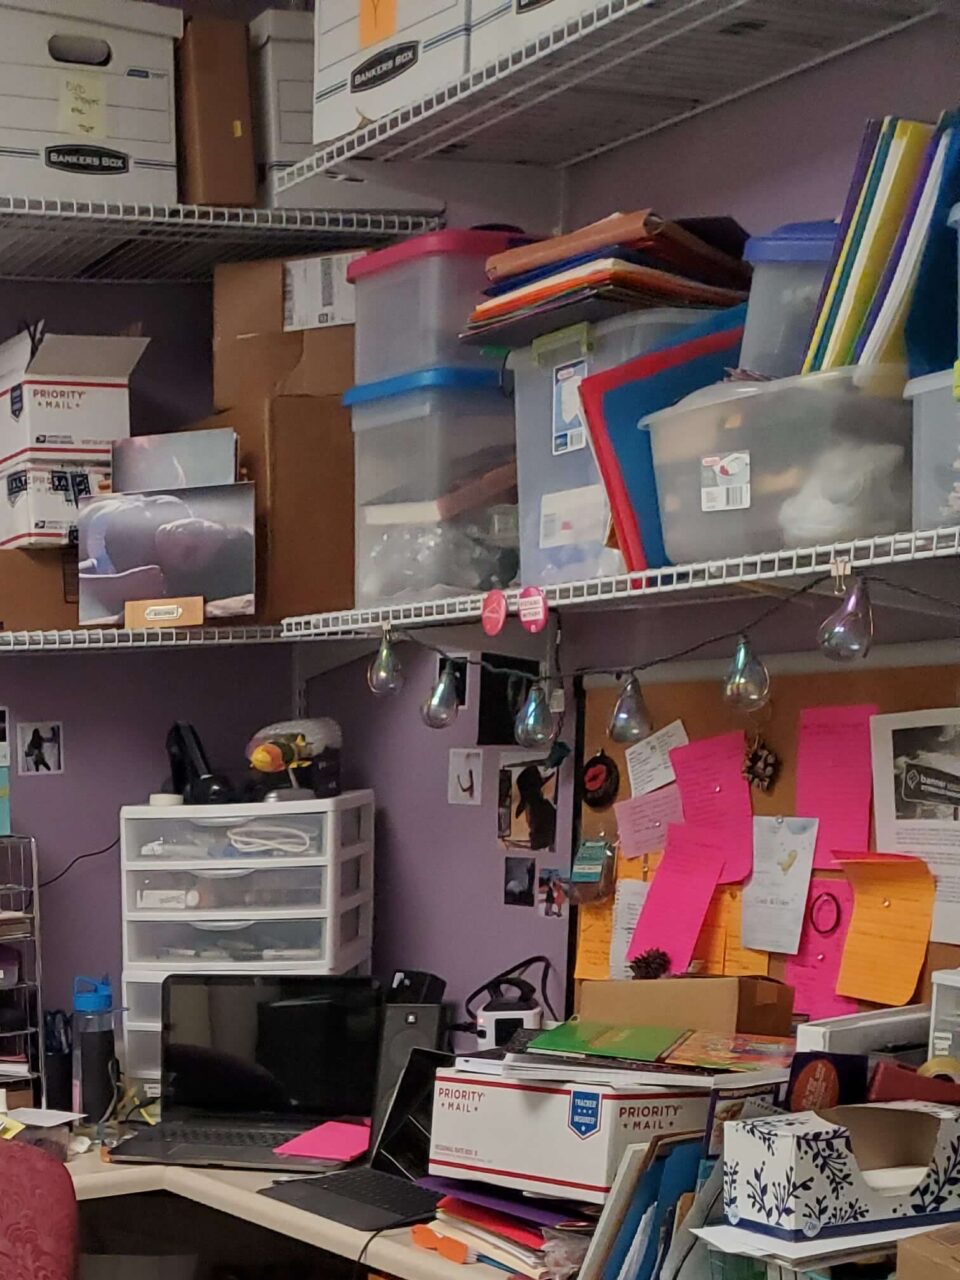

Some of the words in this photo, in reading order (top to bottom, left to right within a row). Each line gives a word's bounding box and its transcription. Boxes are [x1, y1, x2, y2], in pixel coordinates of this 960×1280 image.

[354, 58, 394, 85] BANKERS
[395, 50, 415, 67] BOX
[50, 152, 100, 166] BANKERS
[101, 156, 124, 168] BOX
[32, 389, 84, 399] PRIORITY
[45, 401, 72, 409] MAIL
[438, 1087, 484, 1101] PRIORITY
[447, 1102, 471, 1113] MAIL
[619, 1105, 680, 1118] PRIORITY
[632, 1121, 664, 1130] MAIL
